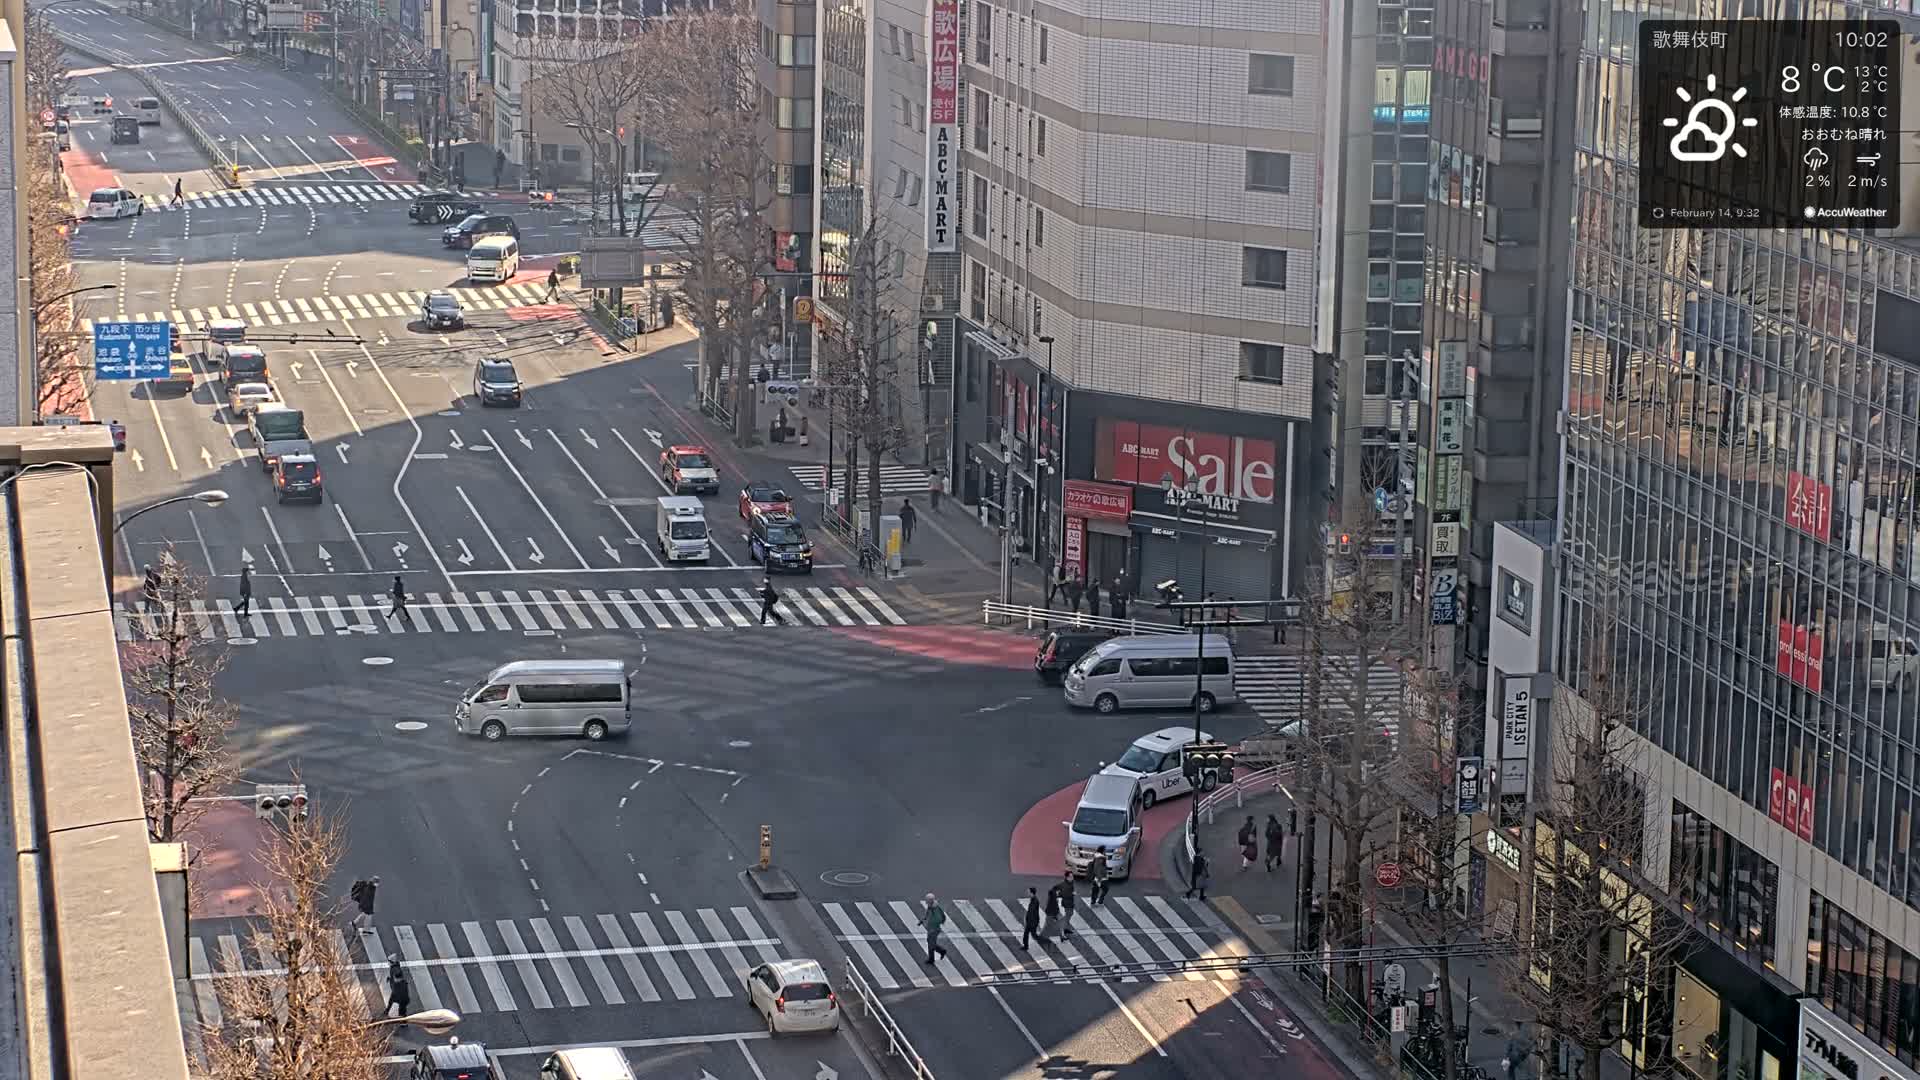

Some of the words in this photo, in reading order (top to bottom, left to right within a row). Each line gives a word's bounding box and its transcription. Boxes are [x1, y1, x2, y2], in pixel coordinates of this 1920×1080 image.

[934, 10, 955, 91] 歌広場
[932, 99, 954, 108] 受付
[933, 110, 954, 120] 5F
[1168, 435, 1275, 504] Sale
[1441, 513, 1452, 522] 7F
[1791, 481, 1826, 531] 会計
[1436, 526, 1449, 553] 買取
[1506, 701, 1515, 715] CITY
[1516, 690, 1528, 703] 5
[1506, 716, 1514, 740] PARK
[1514, 706, 1528, 746] ISETAN
[1161, 777, 1181, 789] Uber
[1773, 779, 1811, 830] CPA
